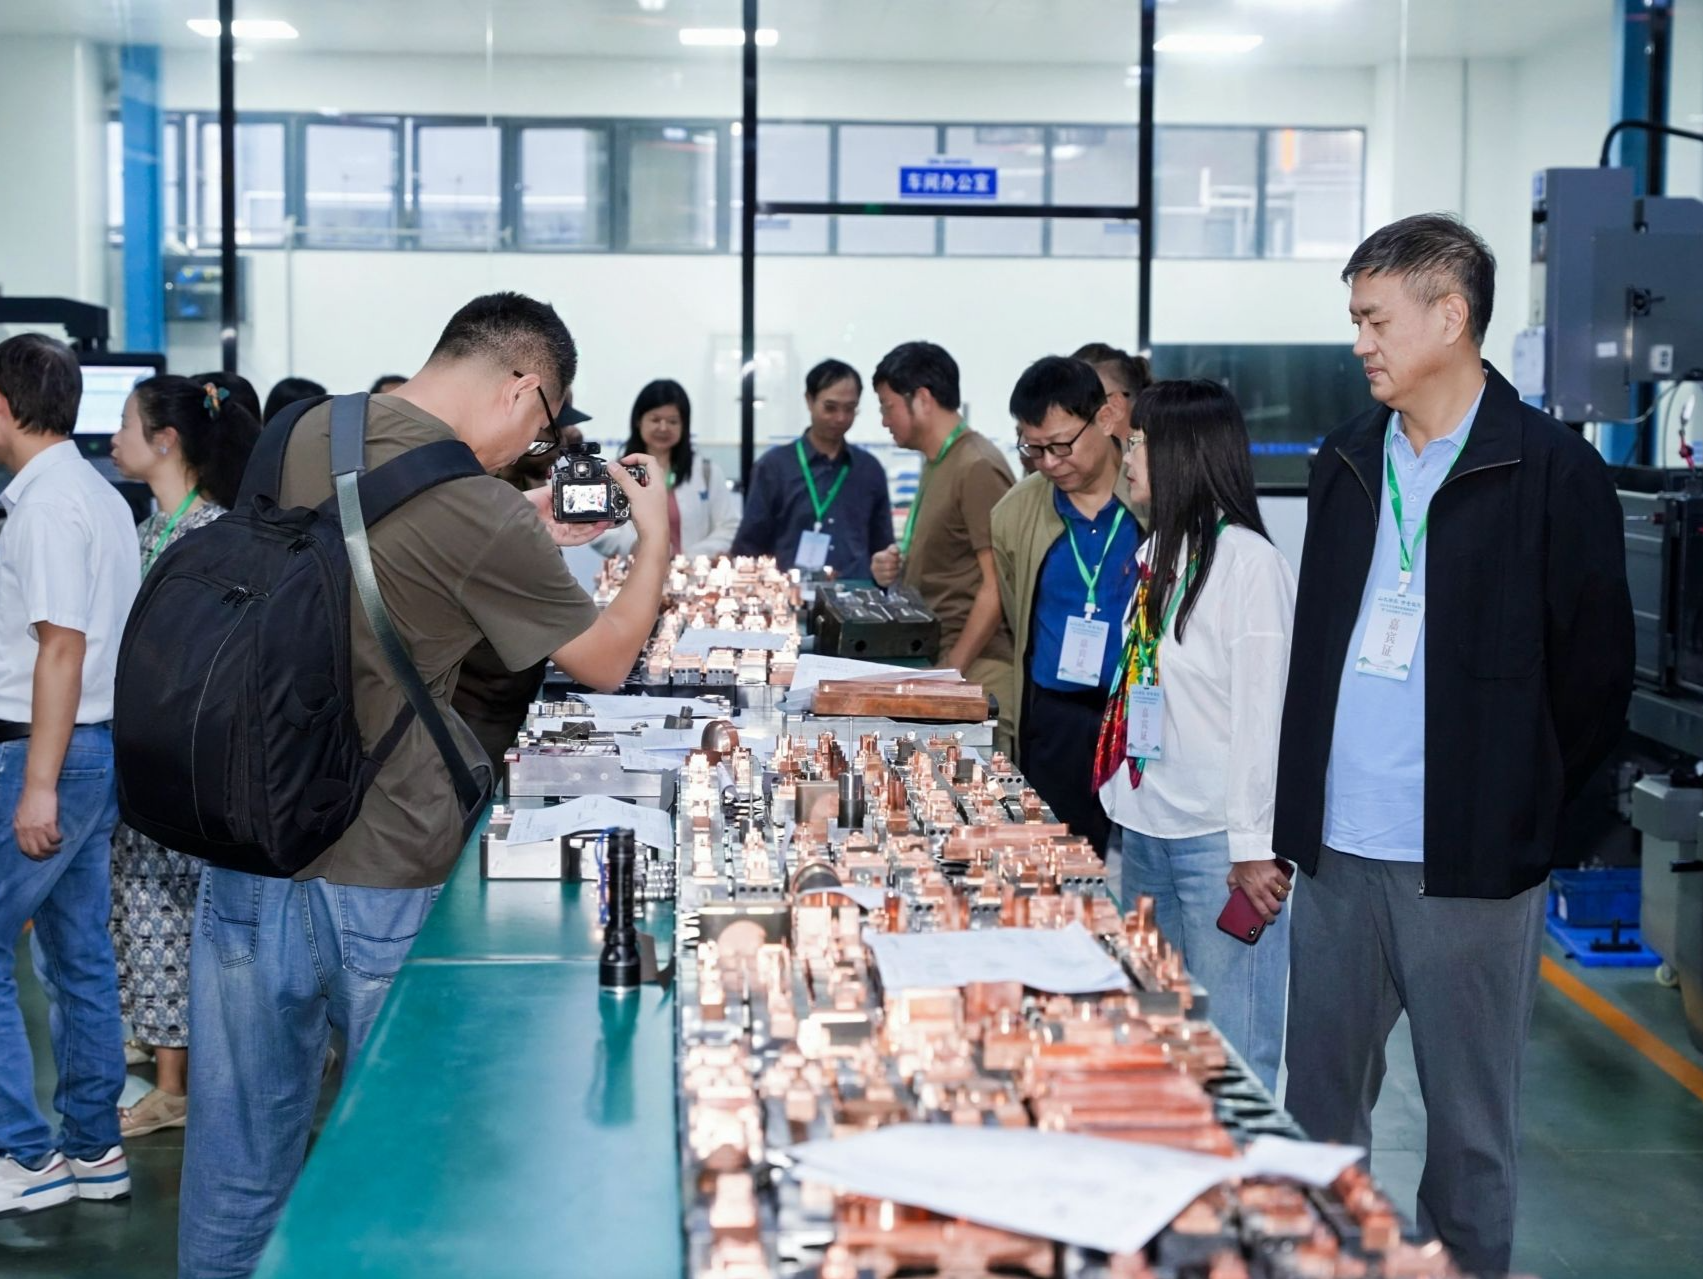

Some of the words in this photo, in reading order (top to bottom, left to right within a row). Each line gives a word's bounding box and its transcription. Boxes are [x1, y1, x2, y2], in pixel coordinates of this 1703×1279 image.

[907, 172, 990, 192] 车间办公室
